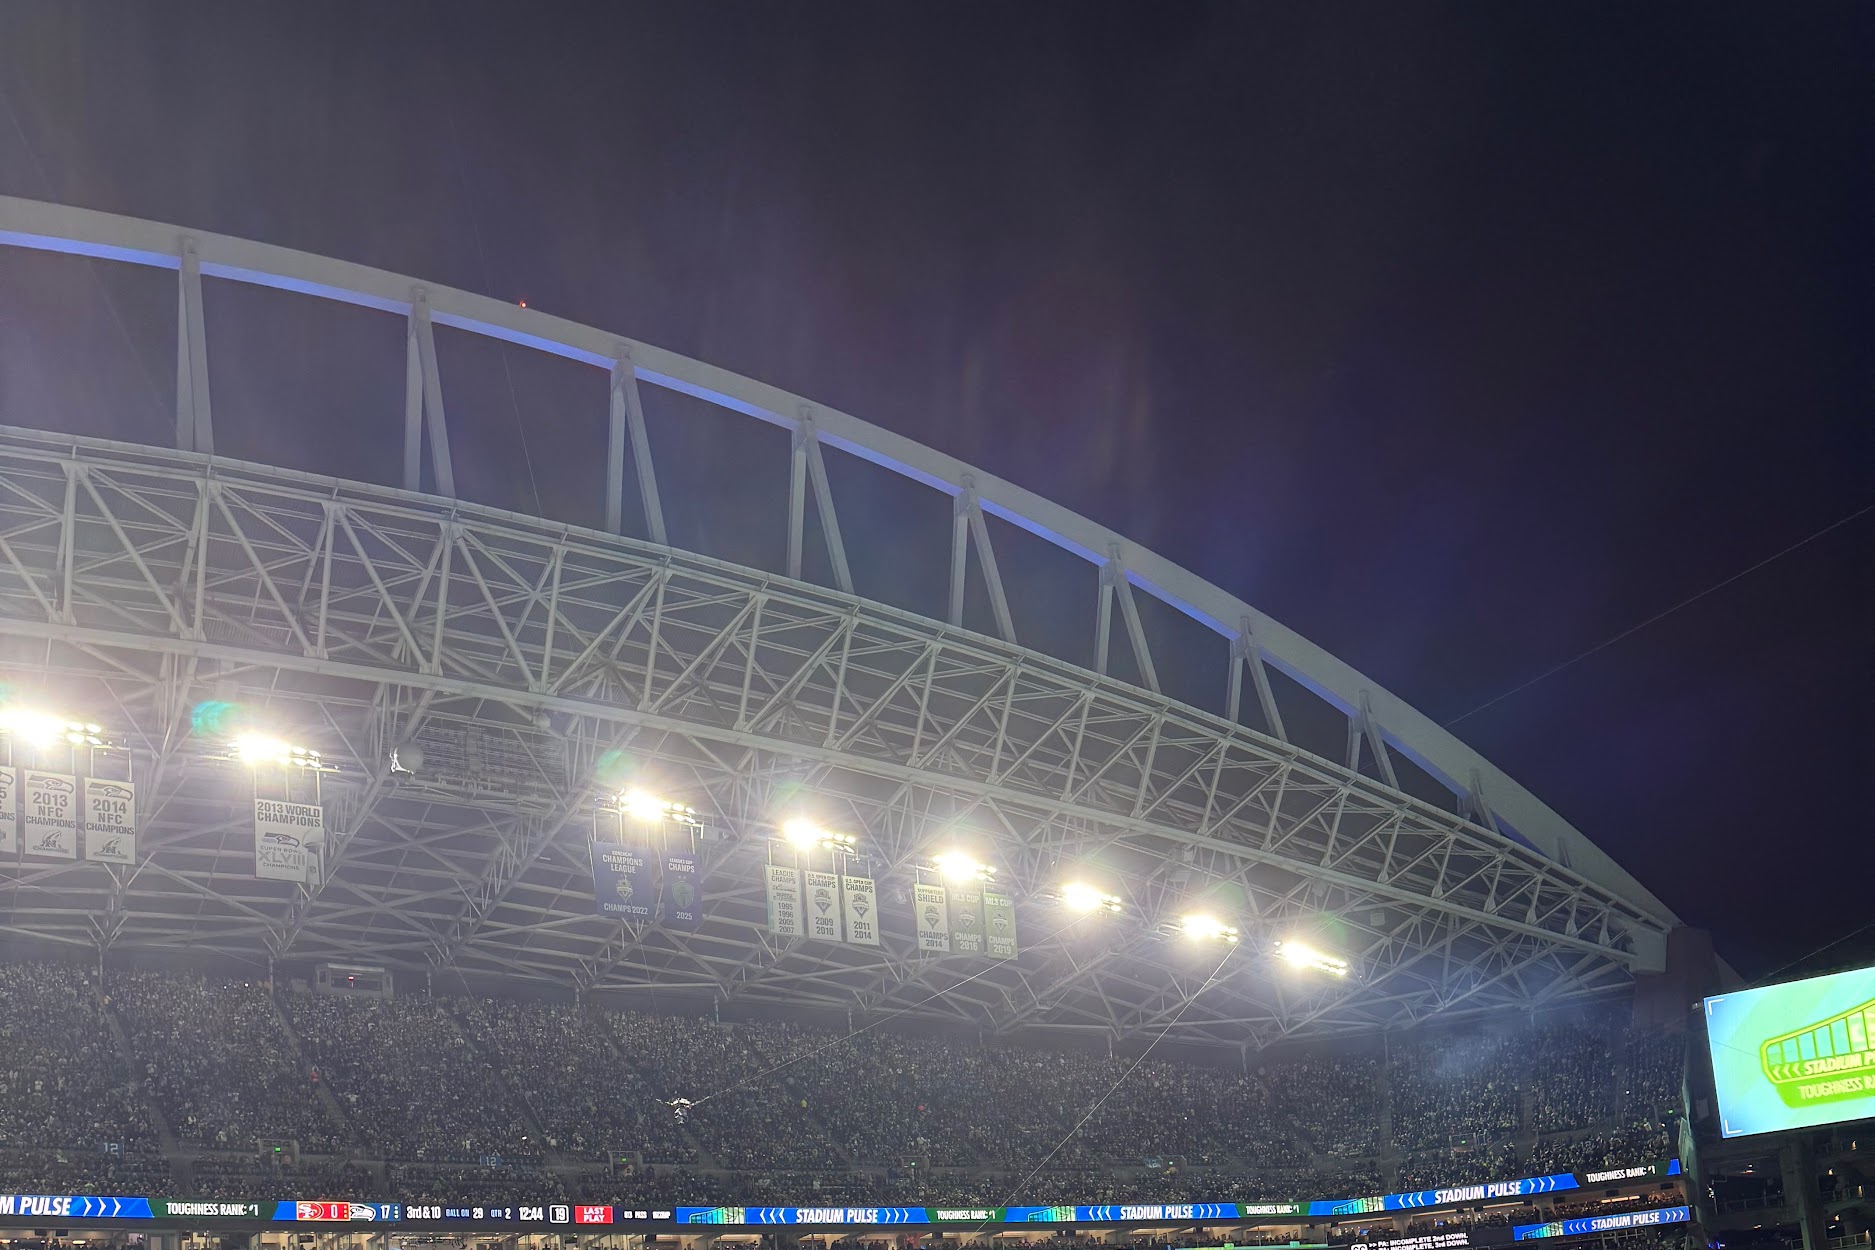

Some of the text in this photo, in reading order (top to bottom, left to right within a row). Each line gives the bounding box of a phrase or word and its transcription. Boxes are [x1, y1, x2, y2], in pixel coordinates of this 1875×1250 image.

[33, 791, 68, 807] 2013
[38, 805, 64, 818] NFC
[92, 799, 127, 814] 2014
[257, 802, 320, 818] 2013 WORLD
[26, 816, 75, 829] CHAMPIONS
[98, 812, 123, 825] NFC
[257, 811, 320, 828] CHAMPIONS
[86, 822, 134, 835] CHAMPIONS
[257, 849, 306, 867] XLVIII
[602, 854, 643, 867] CHAMPIONS
[611, 863, 636, 874] LEAGUE
[668, 863, 695, 873] CHAMPS
[772, 869, 795, 877] LEAGUE
[771, 875, 796, 885] CHAMPS
[808, 879, 836, 889] CHAMPS
[845, 883, 874, 893] CHAMPS
[917, 893, 944, 904] SHIELD
[951, 892, 980, 903] MLS CUP
[985, 896, 1013, 907] MLS CUP
[604, 902, 649, 915] CHAMPS 2022
[676, 911, 693, 920] 2025
[815, 916, 834, 926] 2009
[779, 926, 795, 934] 2007
[816, 926, 834, 936] 2010
[853, 921, 870, 930] 2011
[854, 930, 872, 940] 2014
[919, 930, 949, 941] CHAMPS
[954, 932, 982, 943] CHAMPS
[988, 935, 1015, 946] CHAMPS
[925, 939, 943, 948] 2014
[993, 944, 1012, 955] 2019
[1804, 1053, 1863, 1075] STADIUM
[1797, 1077, 1864, 1100] TOUGHNESS
[1586, 1167, 1647, 1183] TOUGHNESS RANK:
[1434, 1180, 1521, 1204] STADIUM PULSE
[19, 1196, 72, 1216] PULSE
[166, 1202, 218, 1216] TOUGHNESS
[220, 1204, 247, 1216] RANK:
[330, 1205, 338, 1218] 0
[380, 1204, 391, 1219] 17
[583, 1207, 605, 1215] LAST
[1245, 1205, 1276, 1215] TOUGHNESS
[406, 1206, 442, 1219] 3rd & 10
[445, 1208, 460, 1217] BALL
[472, 1208, 484, 1219] 29
[490, 1208, 511, 1219] QTR 2
[518, 1206, 544, 1221] 12:44
[554, 1207, 566, 1220] 19
[583, 1214, 605, 1222] PLAY
[796, 1209, 878, 1223] STADIUM PULSE
[937, 1210, 970, 1220] TOUGHNESS
[1120, 1205, 1193, 1220] STADIUM PULSE
[1591, 1211, 1660, 1230] STADIUM PULSE
[1389, 1236, 1431, 1247] INCOMPLETE
